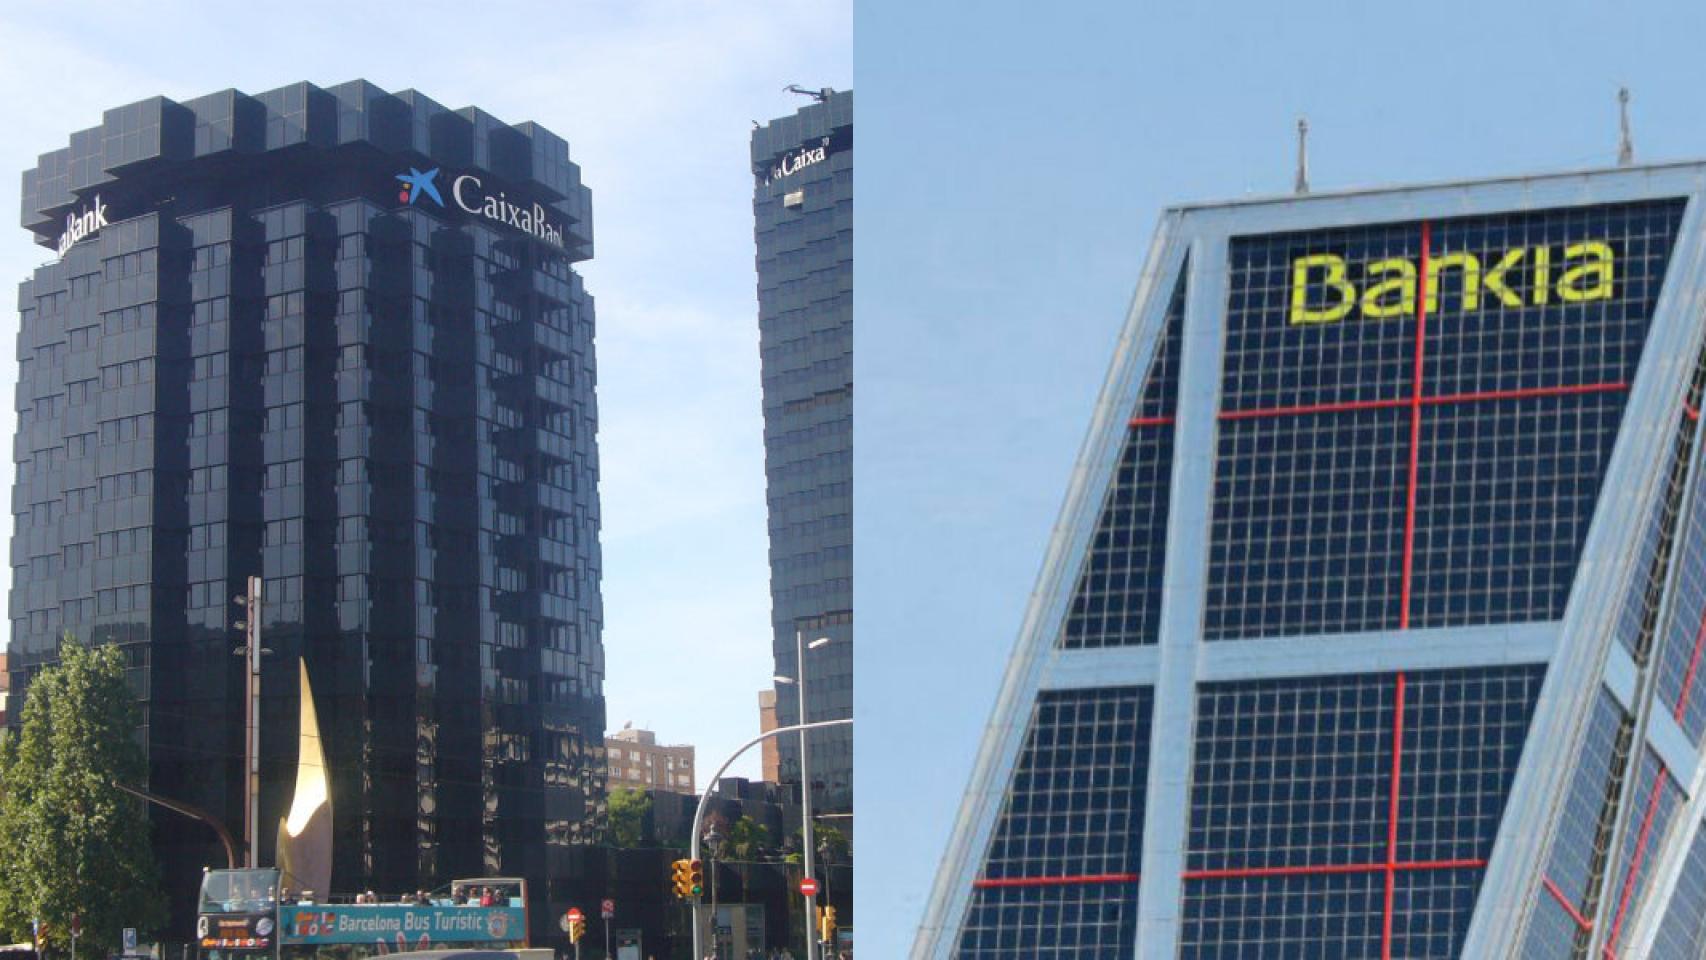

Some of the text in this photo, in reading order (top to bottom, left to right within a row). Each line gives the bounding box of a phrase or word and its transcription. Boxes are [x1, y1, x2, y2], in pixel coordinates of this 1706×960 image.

[1291, 241, 1614, 324] Bankia
[339, 914, 401, 931] Barcelona
[405, 912, 430, 930] Bus
